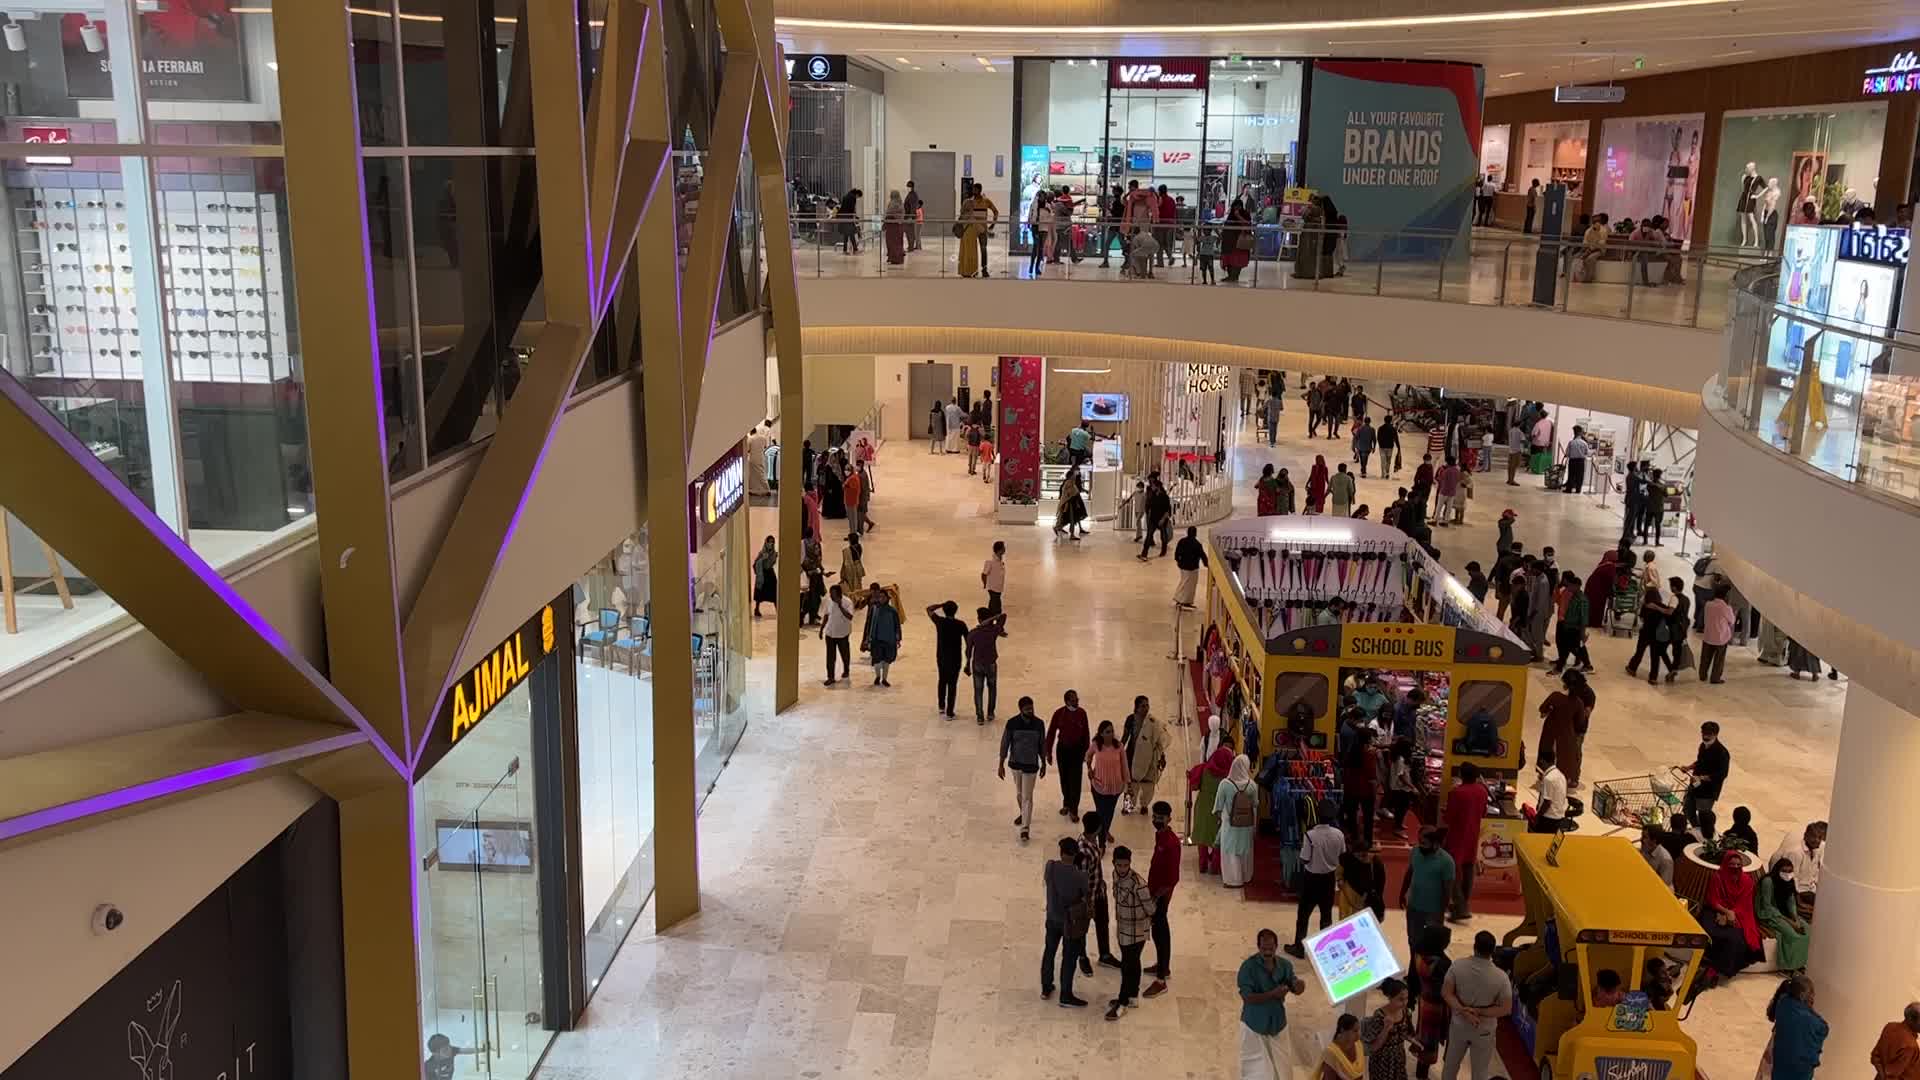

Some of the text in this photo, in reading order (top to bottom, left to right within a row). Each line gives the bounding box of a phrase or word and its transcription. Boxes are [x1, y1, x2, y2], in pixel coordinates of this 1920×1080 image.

[157, 59, 204, 73] FERRARI
[1120, 64, 1162, 82] VIP
[1862, 75, 1905, 94] FASHION
[1347, 111, 1445, 127] ALL YOUR FAVOURITE
[1343, 128, 1442, 165] BRANDS
[1162, 152, 1193, 164] VIP
[1343, 167, 1441, 186] UNDER ONE ROOF
[1351, 637, 1444, 657] SCHOOL BUS
[451, 632, 529, 742] AJMAL
